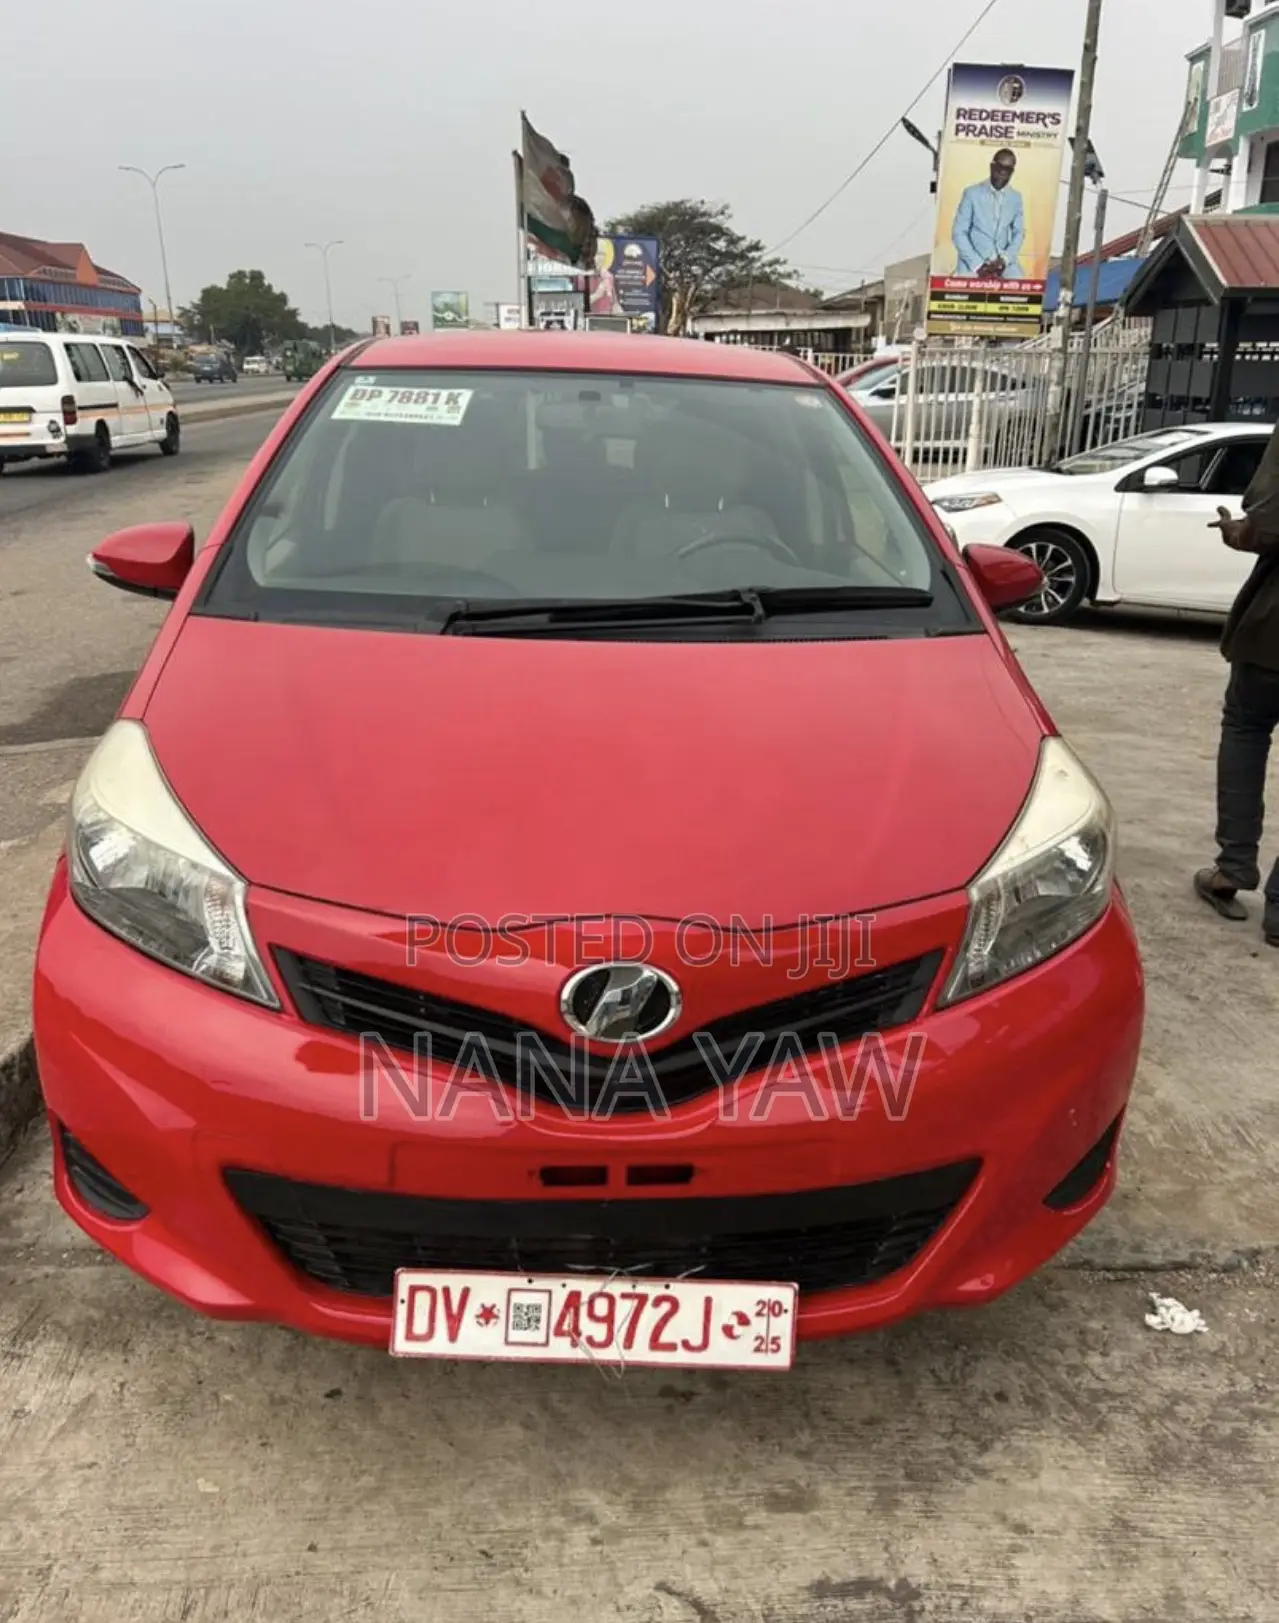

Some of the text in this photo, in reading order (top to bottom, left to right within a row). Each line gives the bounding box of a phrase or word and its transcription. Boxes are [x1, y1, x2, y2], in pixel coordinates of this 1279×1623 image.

[955, 107, 1062, 128] REDEEMER'S
[954, 123, 1059, 139] PRAISE MINISTRY
[944, 278, 967, 288] Come
[969, 279, 1001, 290] worship
[1002, 280, 1020, 289] with
[350, 388, 383, 401] DP
[387, 389, 441, 405] 7881
[754, 1299, 783, 1318] 20
[405, 1284, 713, 1353] DV 4972J
[753, 1335, 782, 1354] 25
